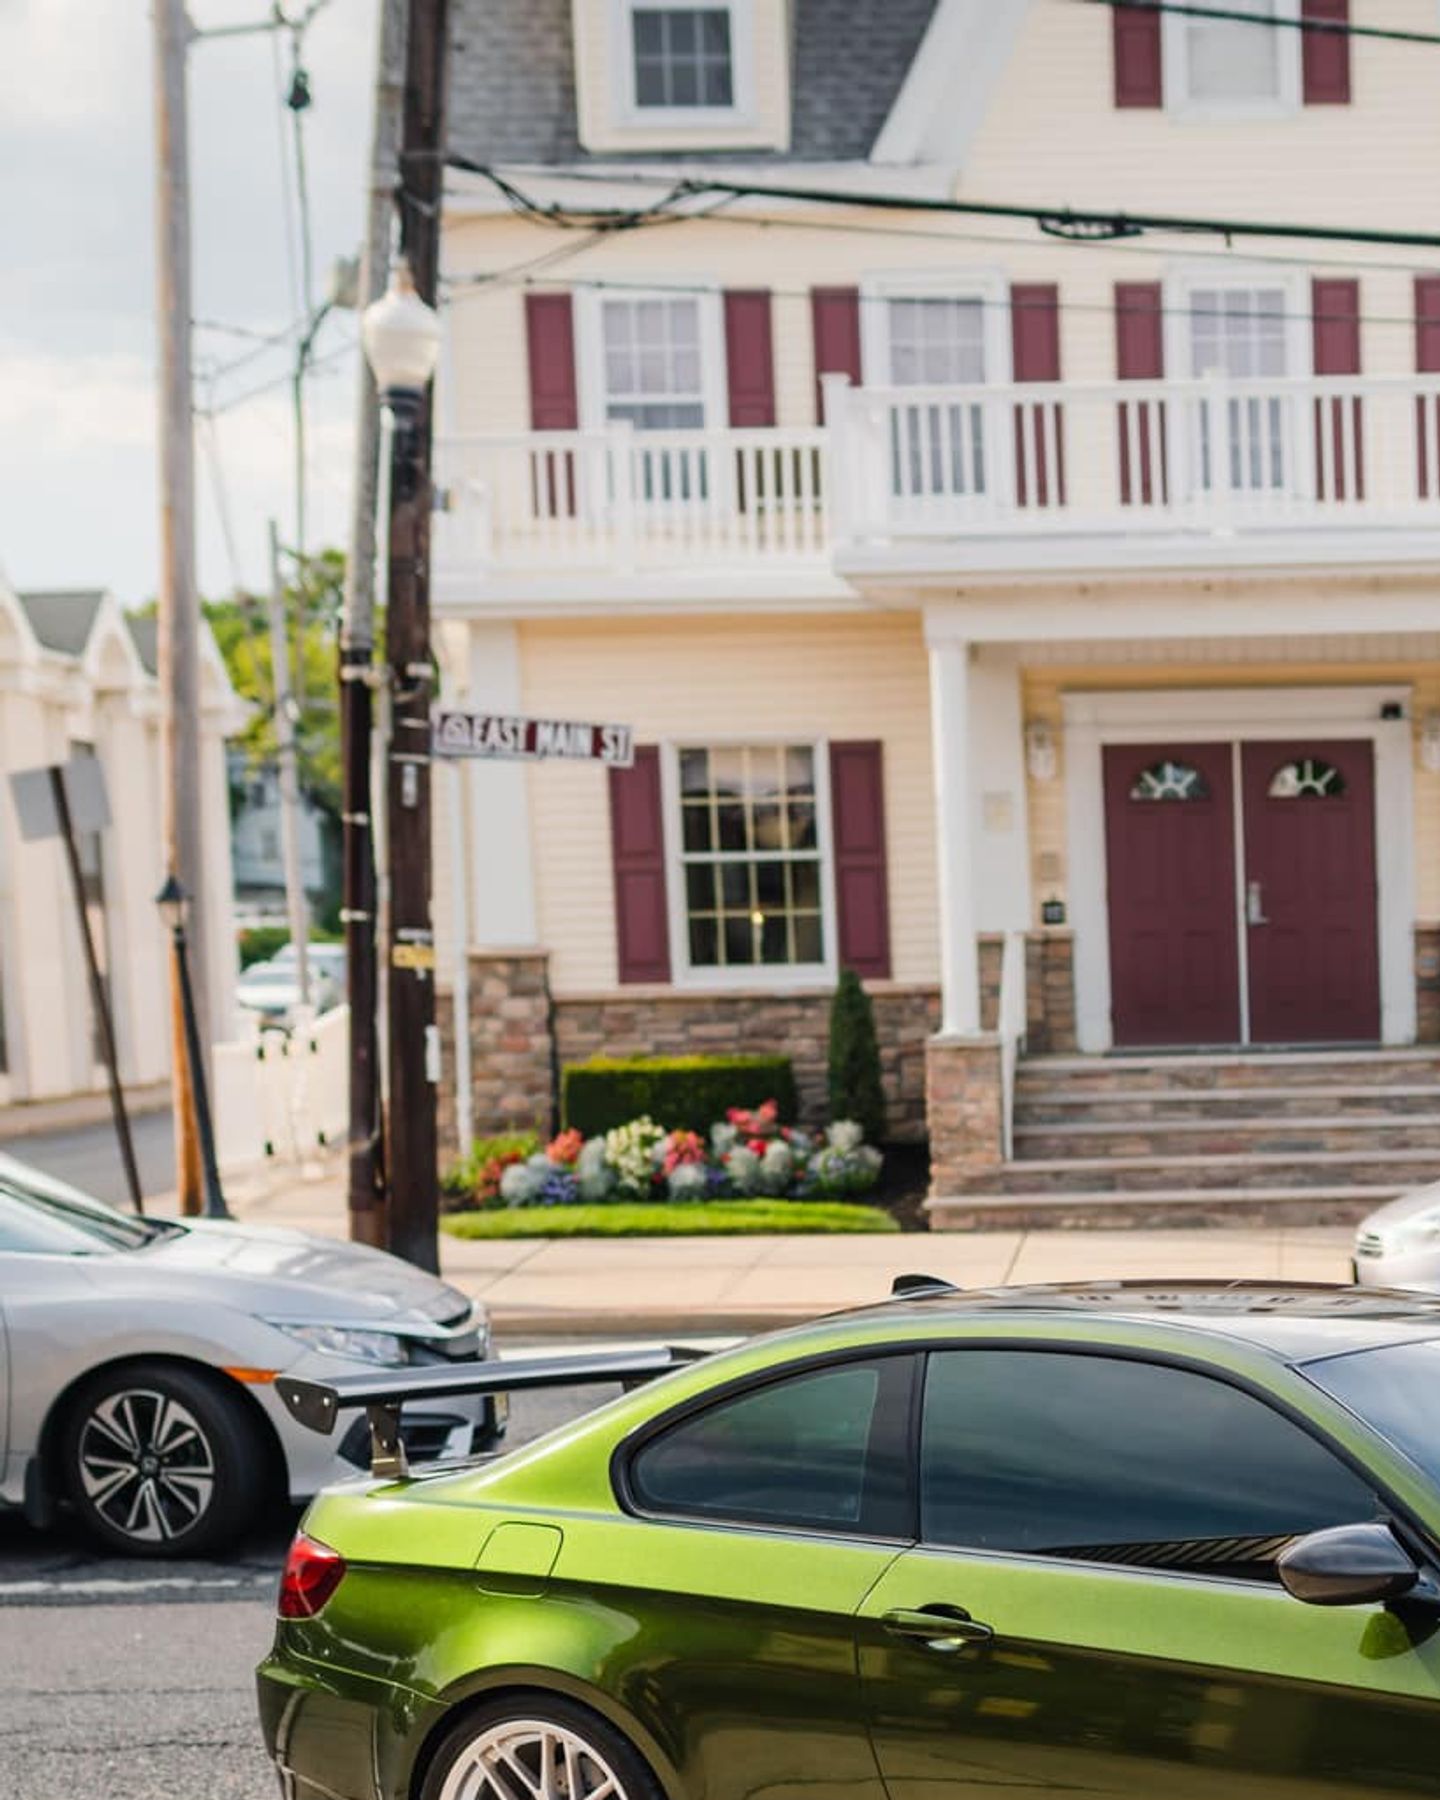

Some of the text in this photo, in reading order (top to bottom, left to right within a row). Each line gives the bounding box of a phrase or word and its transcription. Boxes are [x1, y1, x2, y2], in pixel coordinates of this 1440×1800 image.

[471, 716, 631, 761] EAST MAIN ST
